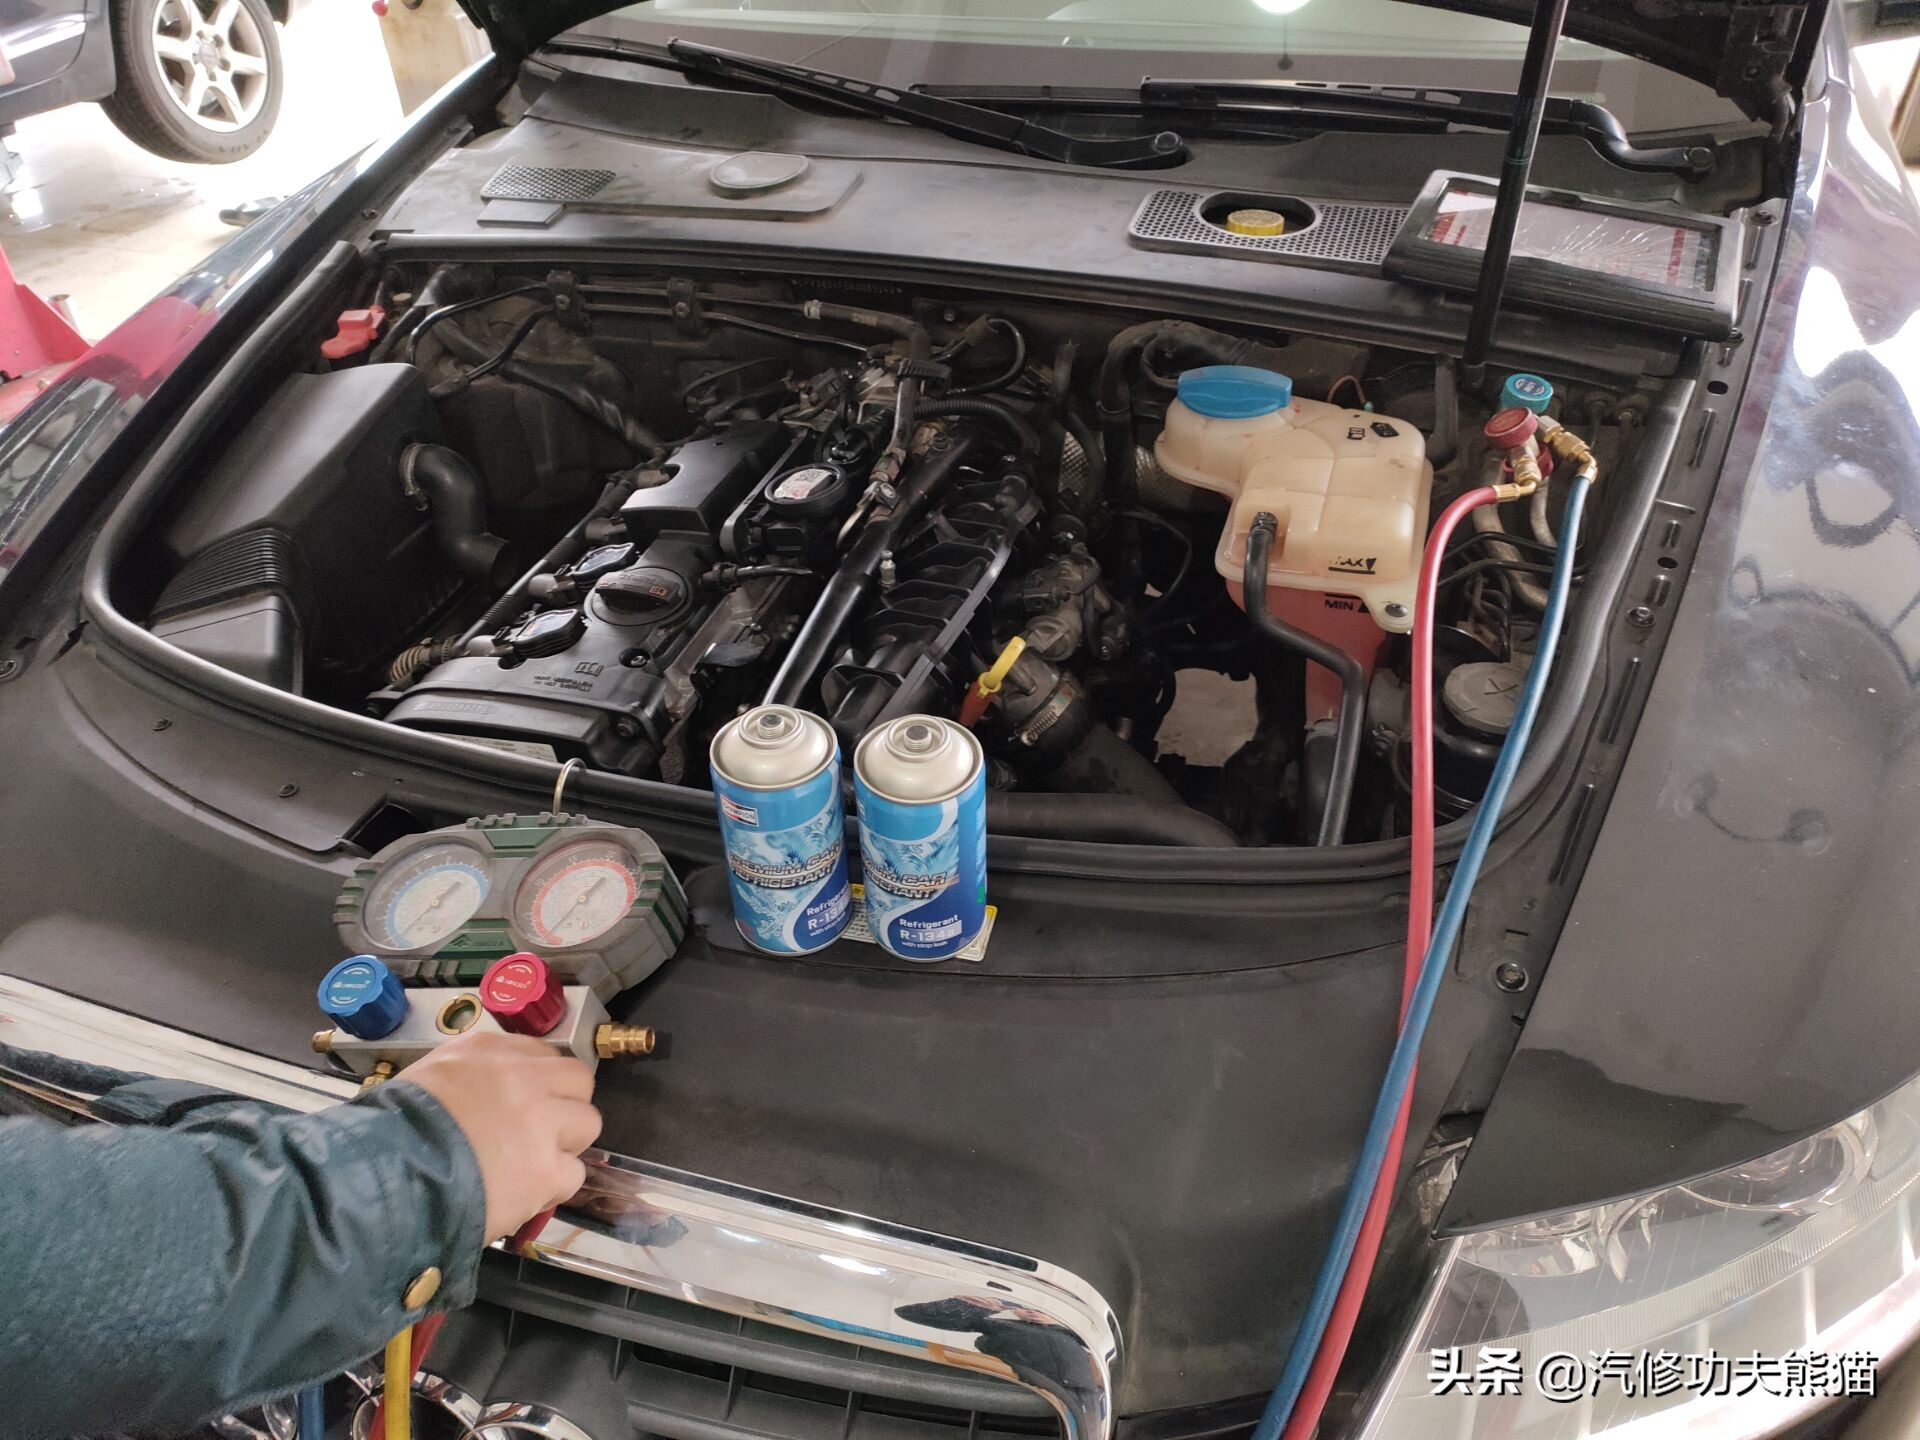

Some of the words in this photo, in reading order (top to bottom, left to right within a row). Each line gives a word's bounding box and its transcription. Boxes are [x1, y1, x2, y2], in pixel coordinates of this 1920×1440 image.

[1323, 599, 1354, 611] MIN
[901, 871, 948, 888] CAR
[900, 914, 959, 929] Refrigerant
